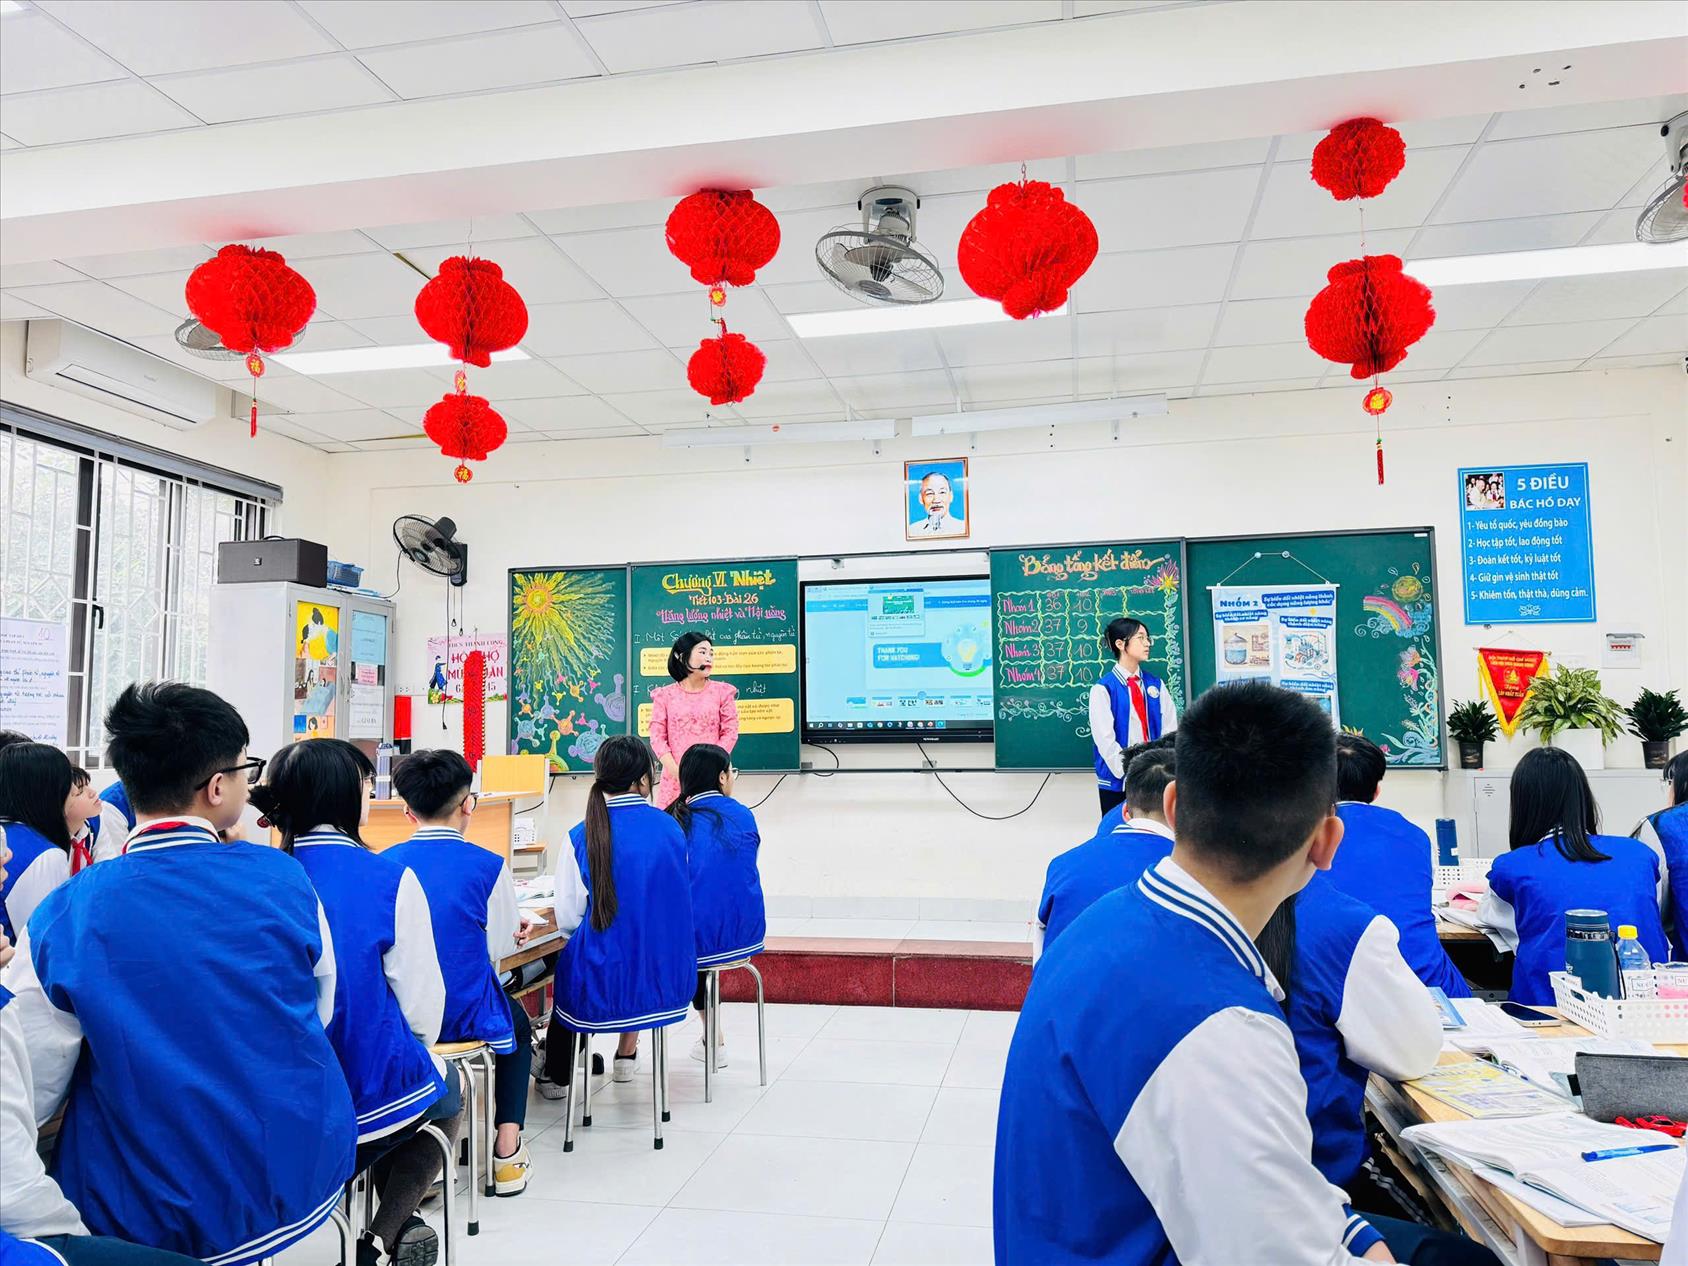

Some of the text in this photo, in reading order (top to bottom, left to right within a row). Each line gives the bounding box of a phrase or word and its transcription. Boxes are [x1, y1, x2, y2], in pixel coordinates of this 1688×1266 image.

[1516, 473, 1568, 490] 5 ĐIỀU
[1510, 498, 1533, 509] BÁC
[1557, 496, 1580, 510] DẠY
[1476, 520, 1488, 530] Yêu
[1499, 518, 1518, 530] quốc,
[1520, 519, 1532, 530] yêu
[1534, 518, 1553, 530] đồng
[1554, 518, 1568, 526] bào
[1476, 538, 1490, 549] Học
[1492, 538, 1504, 549] tập
[1505, 536, 1518, 547] tốt,
[1519, 536, 1530, 546] lao
[1531, 536, 1550, 547] động
[1552, 534, 1562, 544] tốt
[1019, 554, 1068, 580] Bảng
[1064, 550, 1098, 582] tổng
[1094, 548, 1119, 572] kết
[1478, 555, 1496, 564] Đoàn
[1498, 554, 1510, 564] kết
[1510, 552, 1523, 564] tốt,
[1534, 554, 1549, 565] luật
[1550, 552, 1561, 562] tốt
[662, 569, 776, 597] Chương VI Nhiệt
[1478, 572, 1492, 582] Giữ
[1505, 573, 1514, 584] vệ
[1515, 571, 1530, 580] sinh
[1532, 570, 1546, 583] thật
[1548, 569, 1558, 580] tốt
[744, 592, 759, 604] 26
[1480, 590, 1502, 599] Khiêm
[1504, 588, 1517, 600] tốn,
[1518, 589, 1534, 600] thật
[1550, 588, 1570, 600] dũng
[1002, 596, 1026, 612] Nhóm
[1028, 599, 1035, 612] 1
[1045, 598, 1062, 611] 36
[1072, 598, 1092, 612] 10
[1220, 597, 1250, 607] NHÓM
[711, 607, 732, 621] nhiệt
[735, 609, 745, 618] và
[1004, 618, 1088, 635] Nhóm 2 37 9
[733, 632, 750, 644] phân
[766, 629, 788, 642] nguyên
[1046, 641, 1065, 657] 37
[1074, 643, 1092, 657] 10
[1005, 667, 1033, 682] Nhóm
[1047, 665, 1064, 680] 37
[1075, 666, 1093, 682] 10
